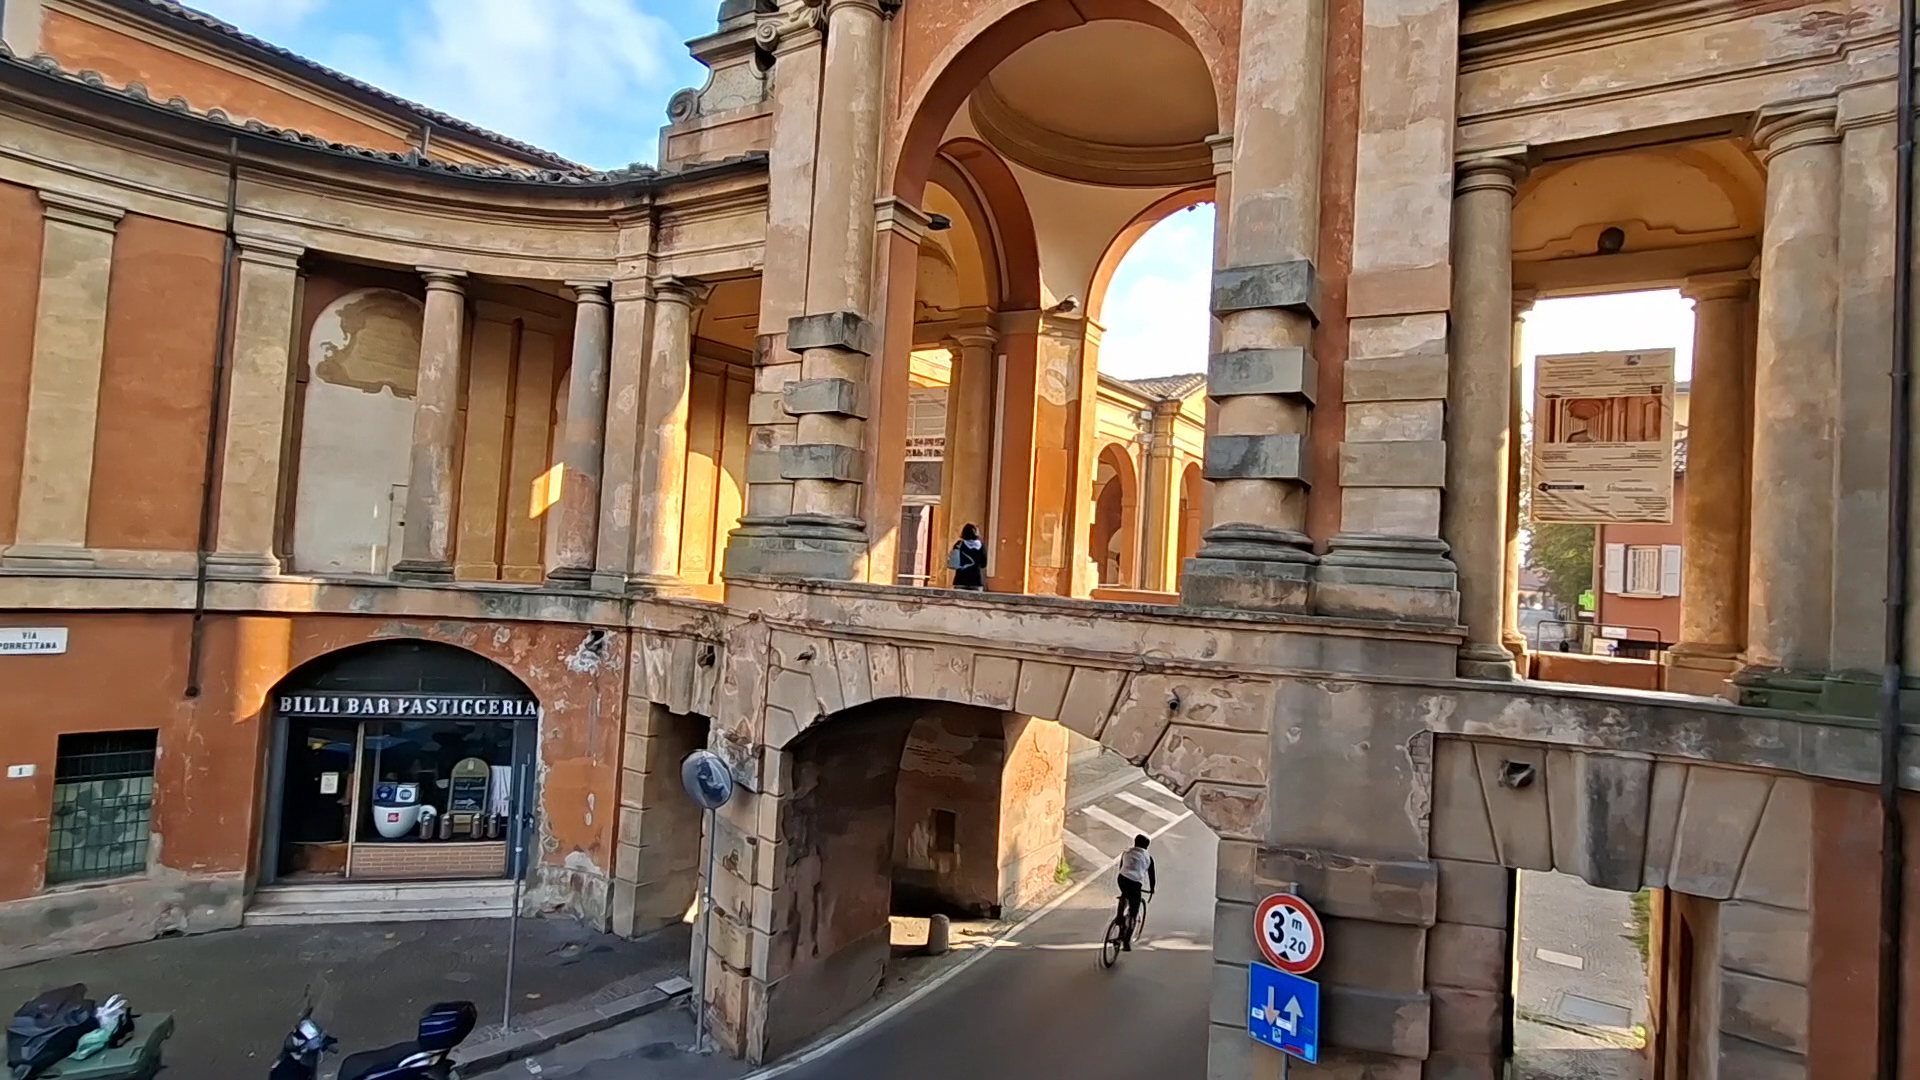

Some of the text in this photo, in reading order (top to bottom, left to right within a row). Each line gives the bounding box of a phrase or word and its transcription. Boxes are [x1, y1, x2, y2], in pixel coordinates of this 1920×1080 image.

[22, 631, 37, 639] VIA
[279, 696, 537, 715] BILLI BAR PASTICCERIA
[1269, 910, 1285, 944] 3
